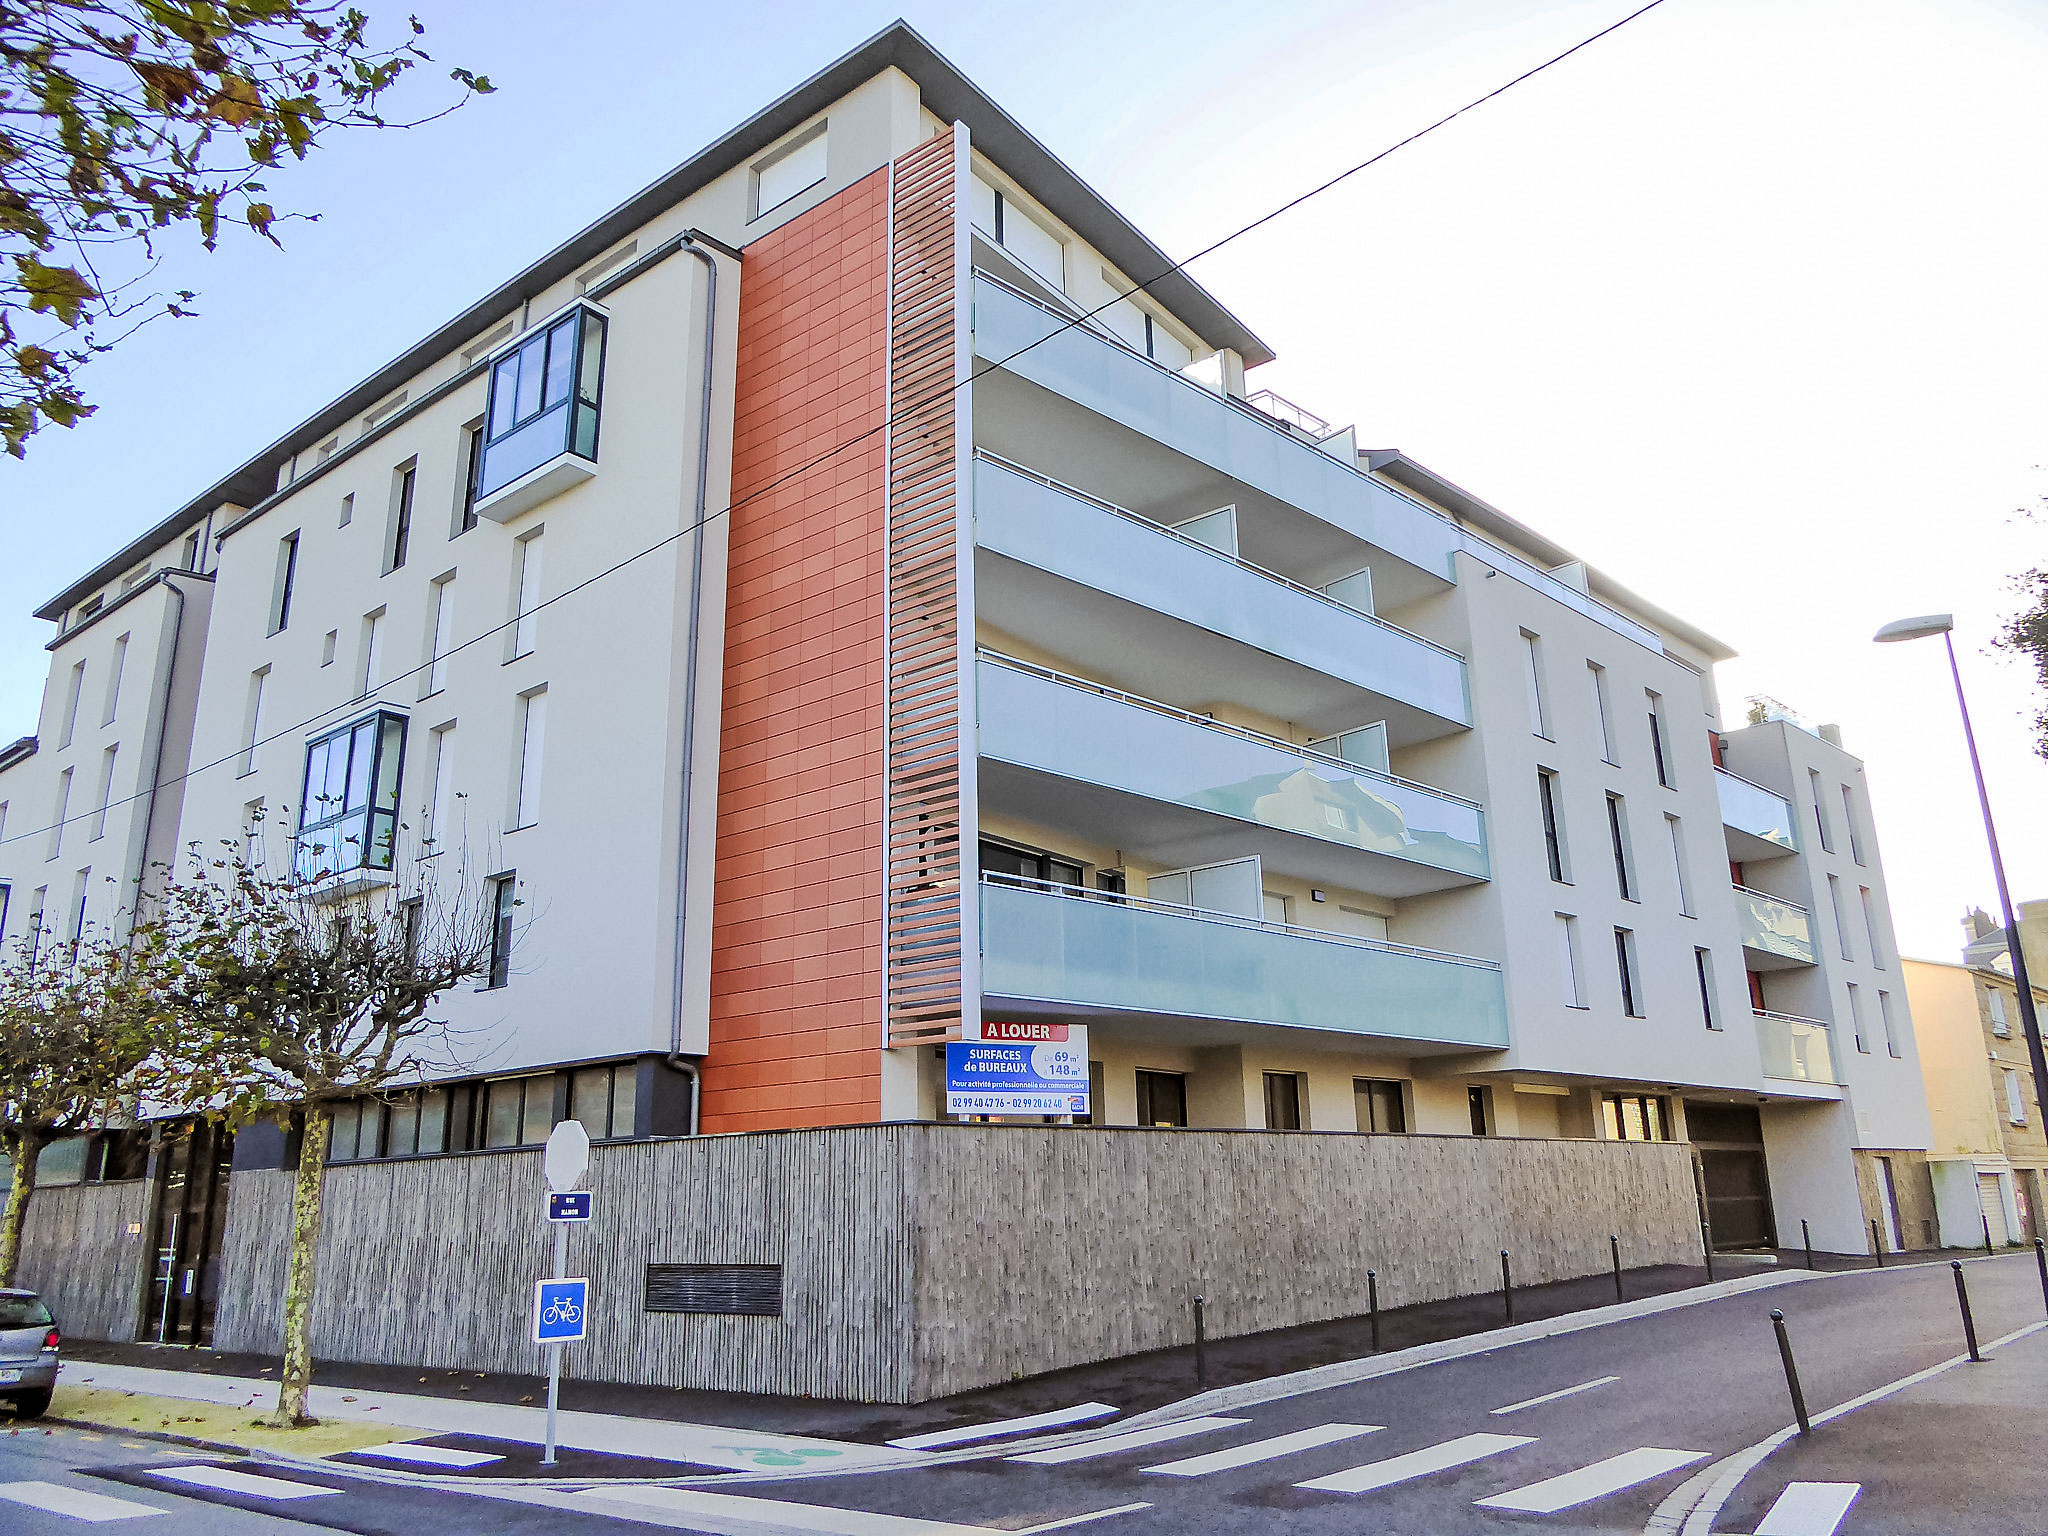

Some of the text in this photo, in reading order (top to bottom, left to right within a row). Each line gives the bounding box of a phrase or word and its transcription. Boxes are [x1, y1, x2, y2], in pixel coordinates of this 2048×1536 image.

[987, 1023, 1050, 1038] A LOUER
[969, 1048, 1021, 1060] SURFACES
[1054, 1051, 1069, 1062] 69
[963, 1062, 1027, 1073] de BUREAUX
[1049, 1065, 1070, 1075] 148
[968, 1080, 991, 1088] activité
[992, 1081, 1038, 1090] professionnelle
[952, 1098, 962, 1107] 02
[963, 1098, 973, 1107] 99
[974, 1098, 984, 1107] 40
[995, 1099, 1005, 1107] 76
[1012, 1099, 1022, 1108] 02
[1023, 1099, 1032, 1108] 99
[1033, 1099, 1042, 1108] 20
